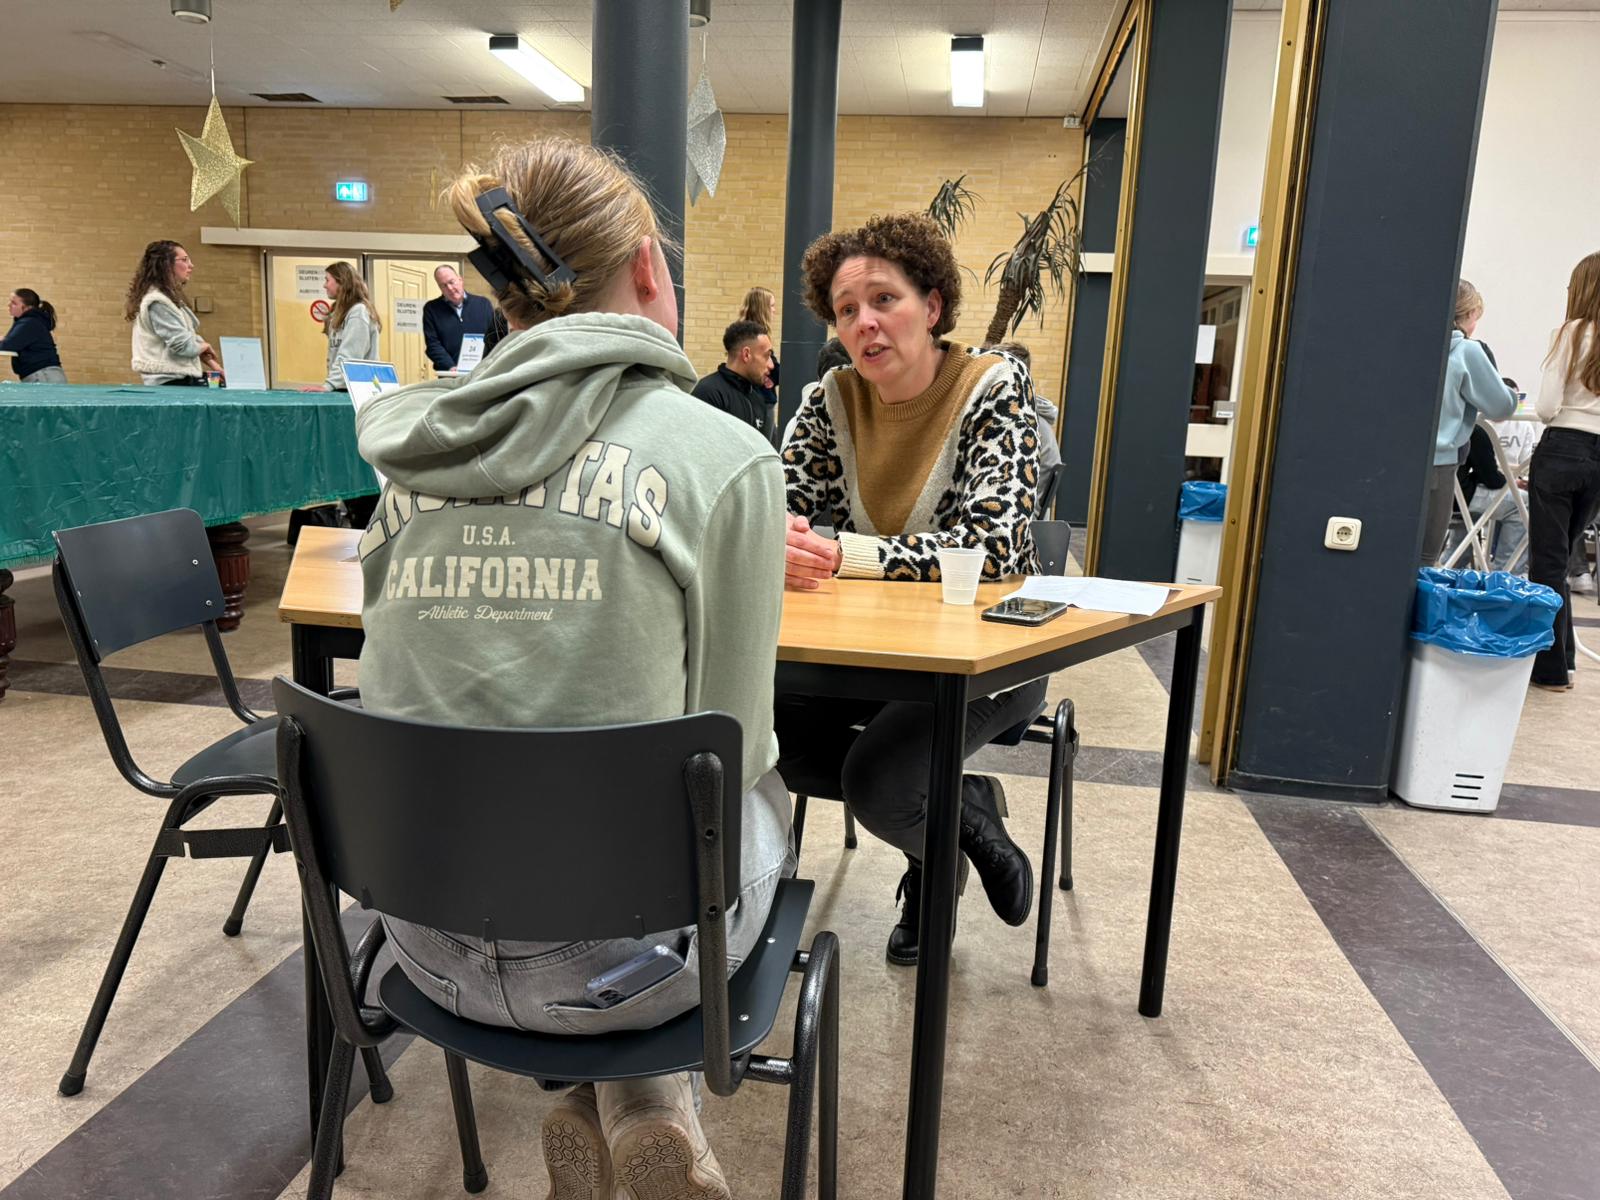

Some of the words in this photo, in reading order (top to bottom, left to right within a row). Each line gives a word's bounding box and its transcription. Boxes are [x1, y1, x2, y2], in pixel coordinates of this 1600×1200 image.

[1500, 435, 1521, 448] SA
[463, 525, 515, 545] U.S.A.
[386, 556, 602, 600] CALIFORNIA
[418, 605, 469, 620] Athletic
[474, 605, 554, 623] Department
